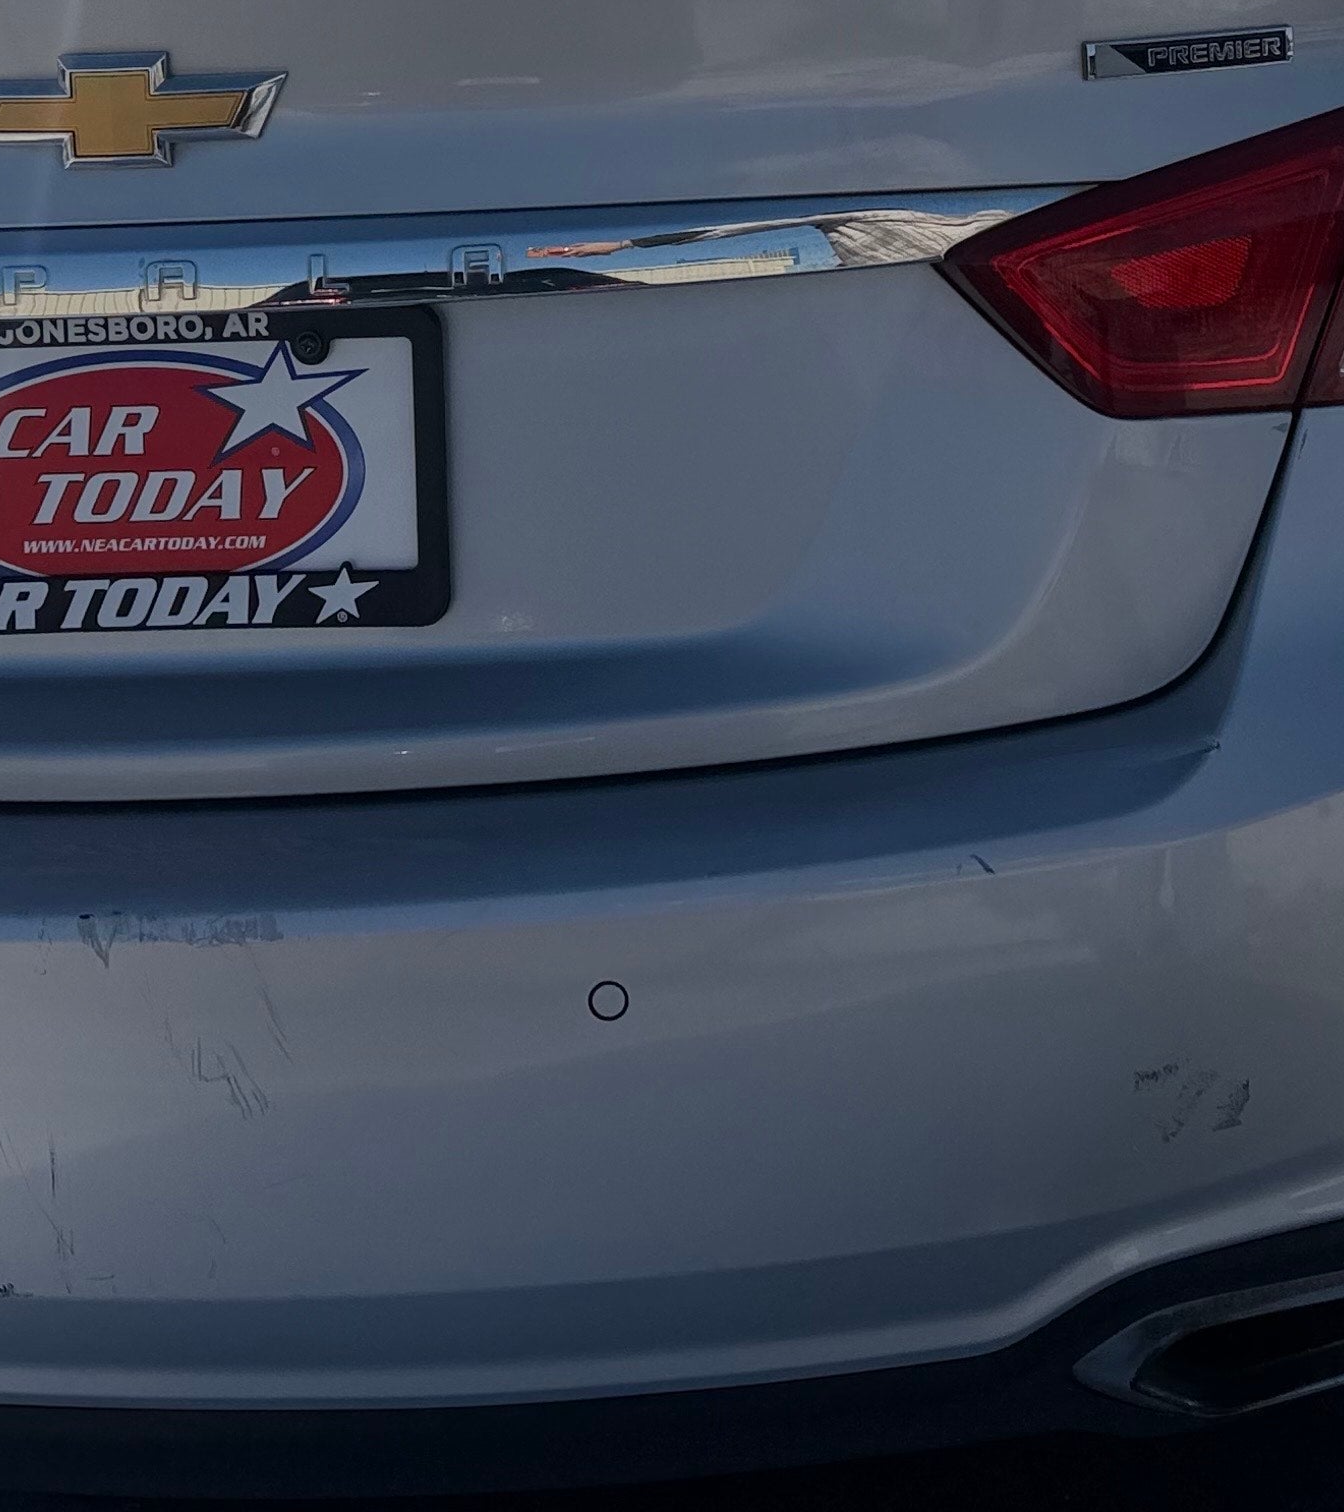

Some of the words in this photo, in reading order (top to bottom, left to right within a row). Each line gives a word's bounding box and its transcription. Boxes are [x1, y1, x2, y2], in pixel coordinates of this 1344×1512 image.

[1147, 36, 1282, 67] PREMIER
[222, 311, 270, 338] AR
[31, 467, 316, 526] TODAY
[23, 535, 267, 554] WWW.NEACARTODAY.COM
[60, 573, 307, 630] TODAY
